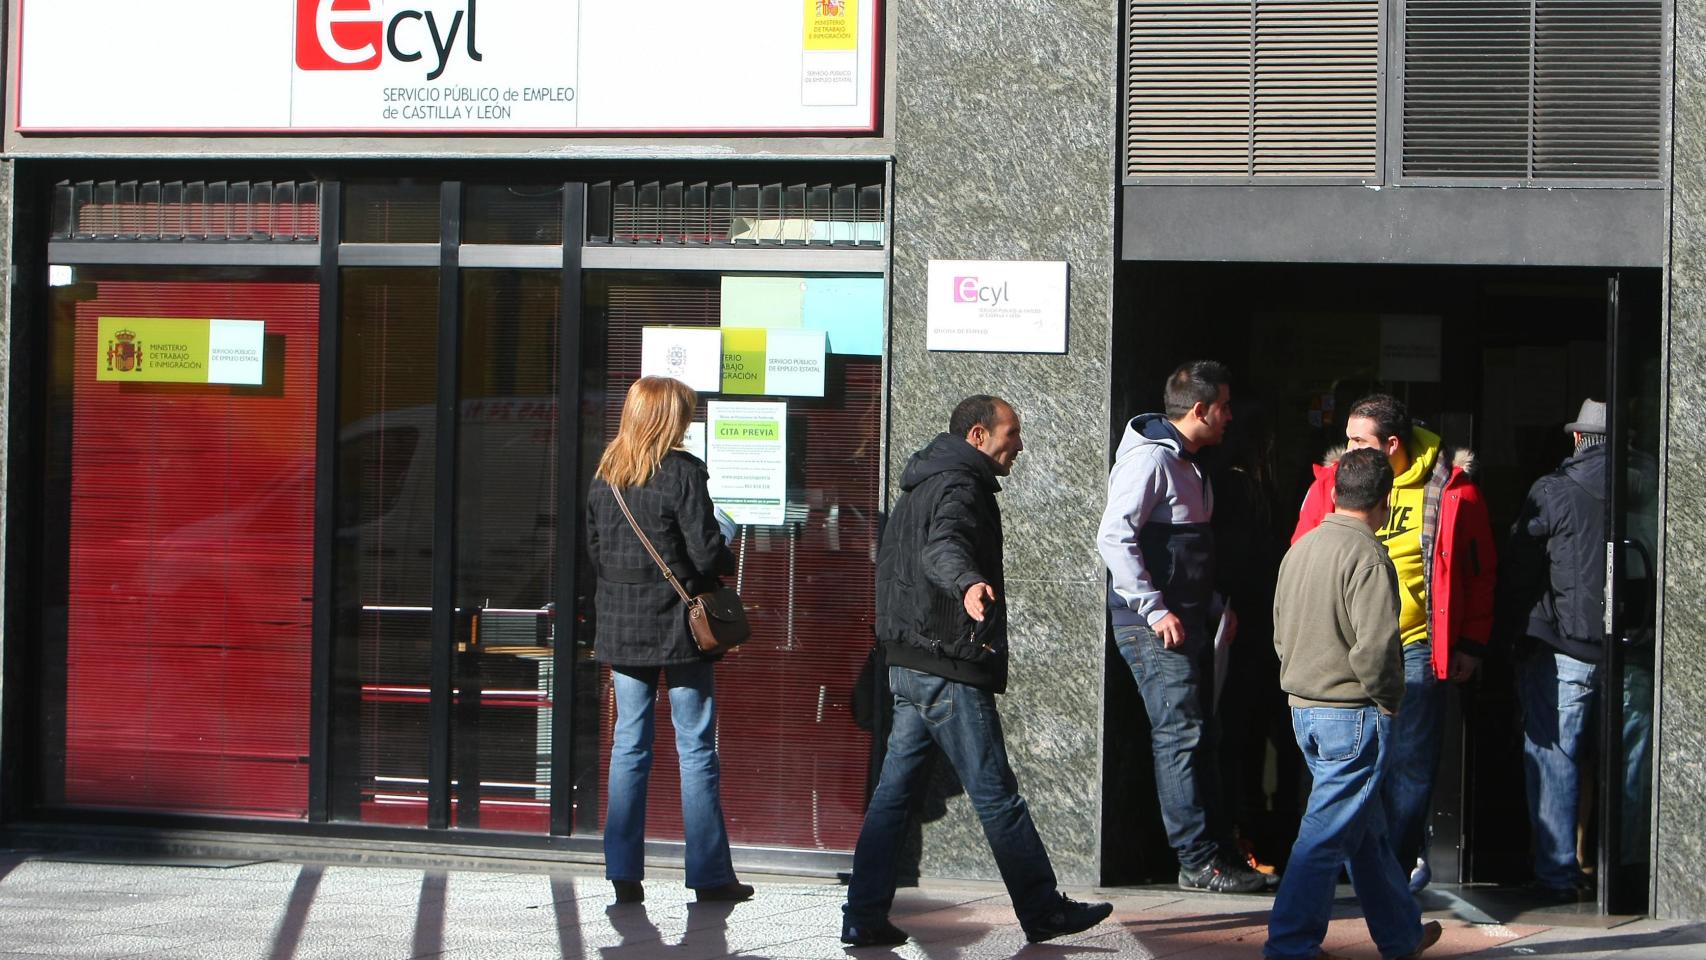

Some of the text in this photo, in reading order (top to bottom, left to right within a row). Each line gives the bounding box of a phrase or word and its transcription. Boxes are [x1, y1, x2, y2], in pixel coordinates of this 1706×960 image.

[314, 0, 482, 81] ecyl
[383, 84, 575, 102] SERVICIO PÚBLICO de EMPLEO
[383, 102, 511, 119] de CASTILLA Y LEÓN
[958, 277, 1009, 307] ecyl
[150, 344, 187, 352] MINISTERIO
[160, 353, 189, 362] TRABAJO
[155, 360, 202, 369] INMIGRACIÓN
[720, 428, 774, 437] CITA PREVIA
